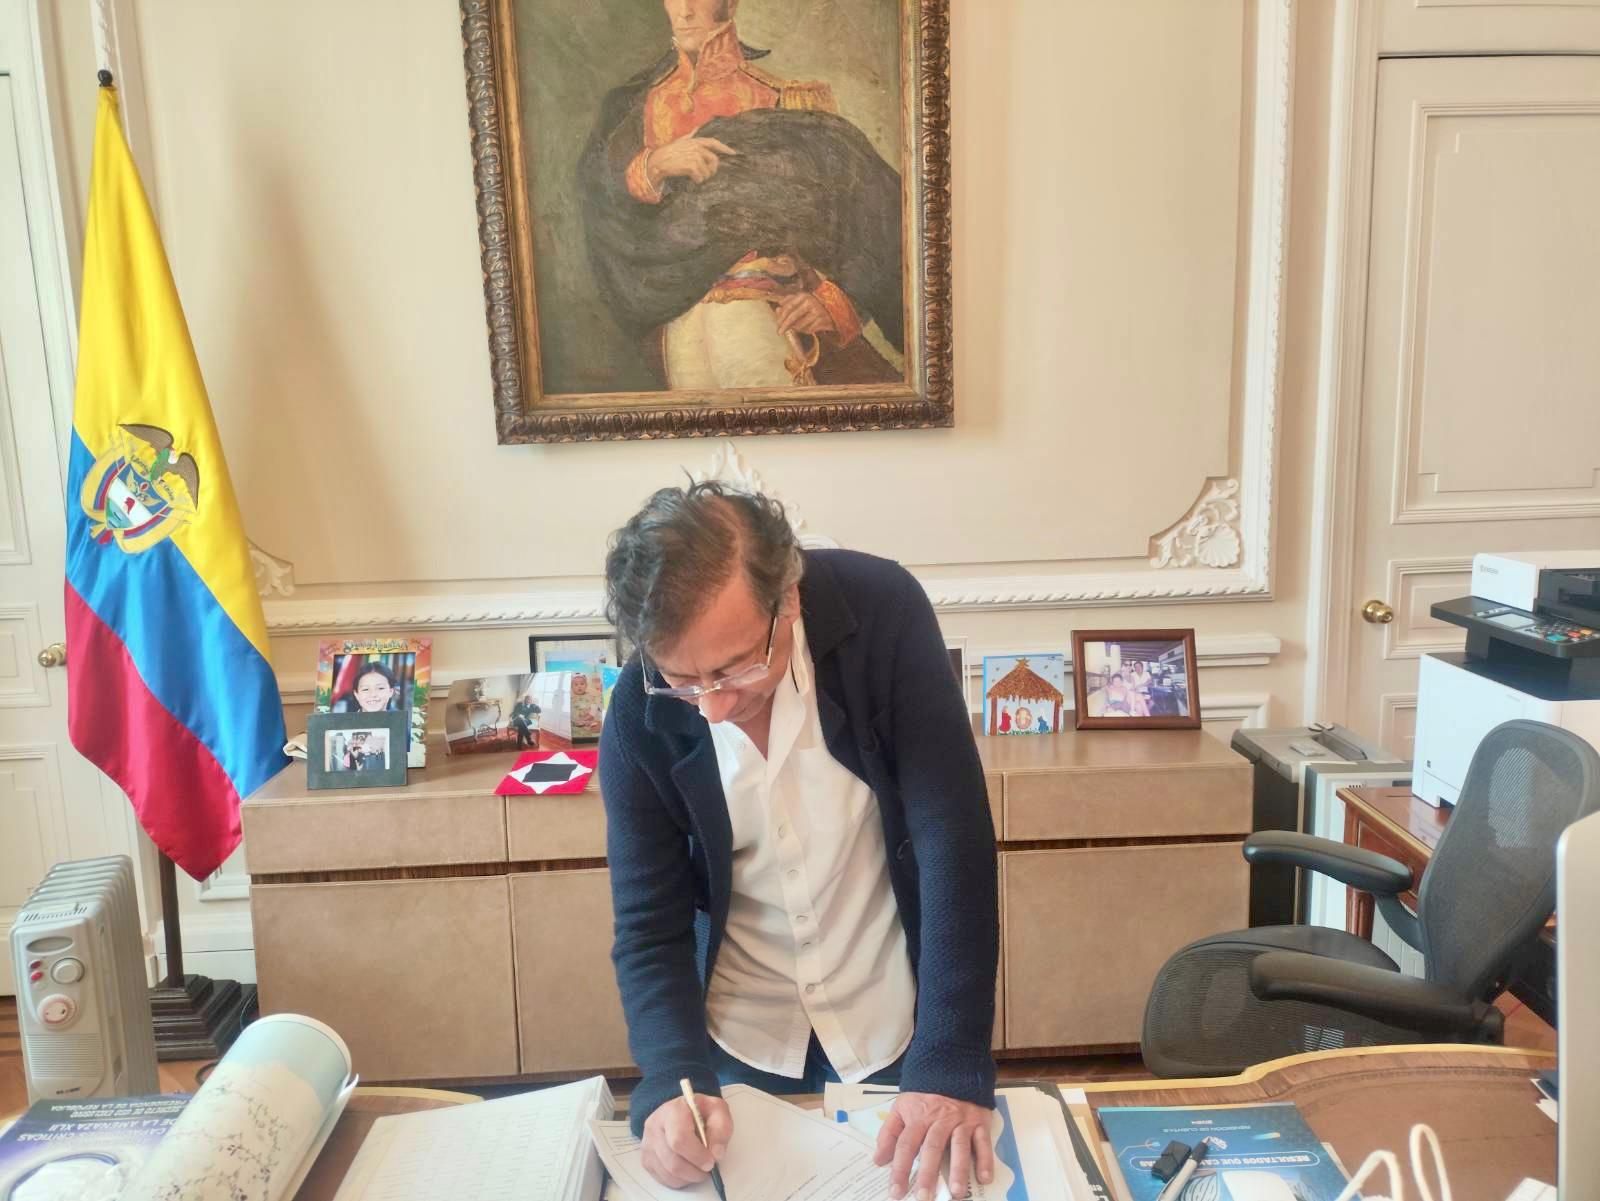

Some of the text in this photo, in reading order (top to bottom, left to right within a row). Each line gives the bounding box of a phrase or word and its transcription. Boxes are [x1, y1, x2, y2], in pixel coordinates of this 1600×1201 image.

[77, 1121, 138, 1131] AMENAZA
[142, 1119, 158, 1127] LA
[1220, 1158, 1242, 1166] QUE
[1243, 1155, 1311, 1165] RESULTADOS
